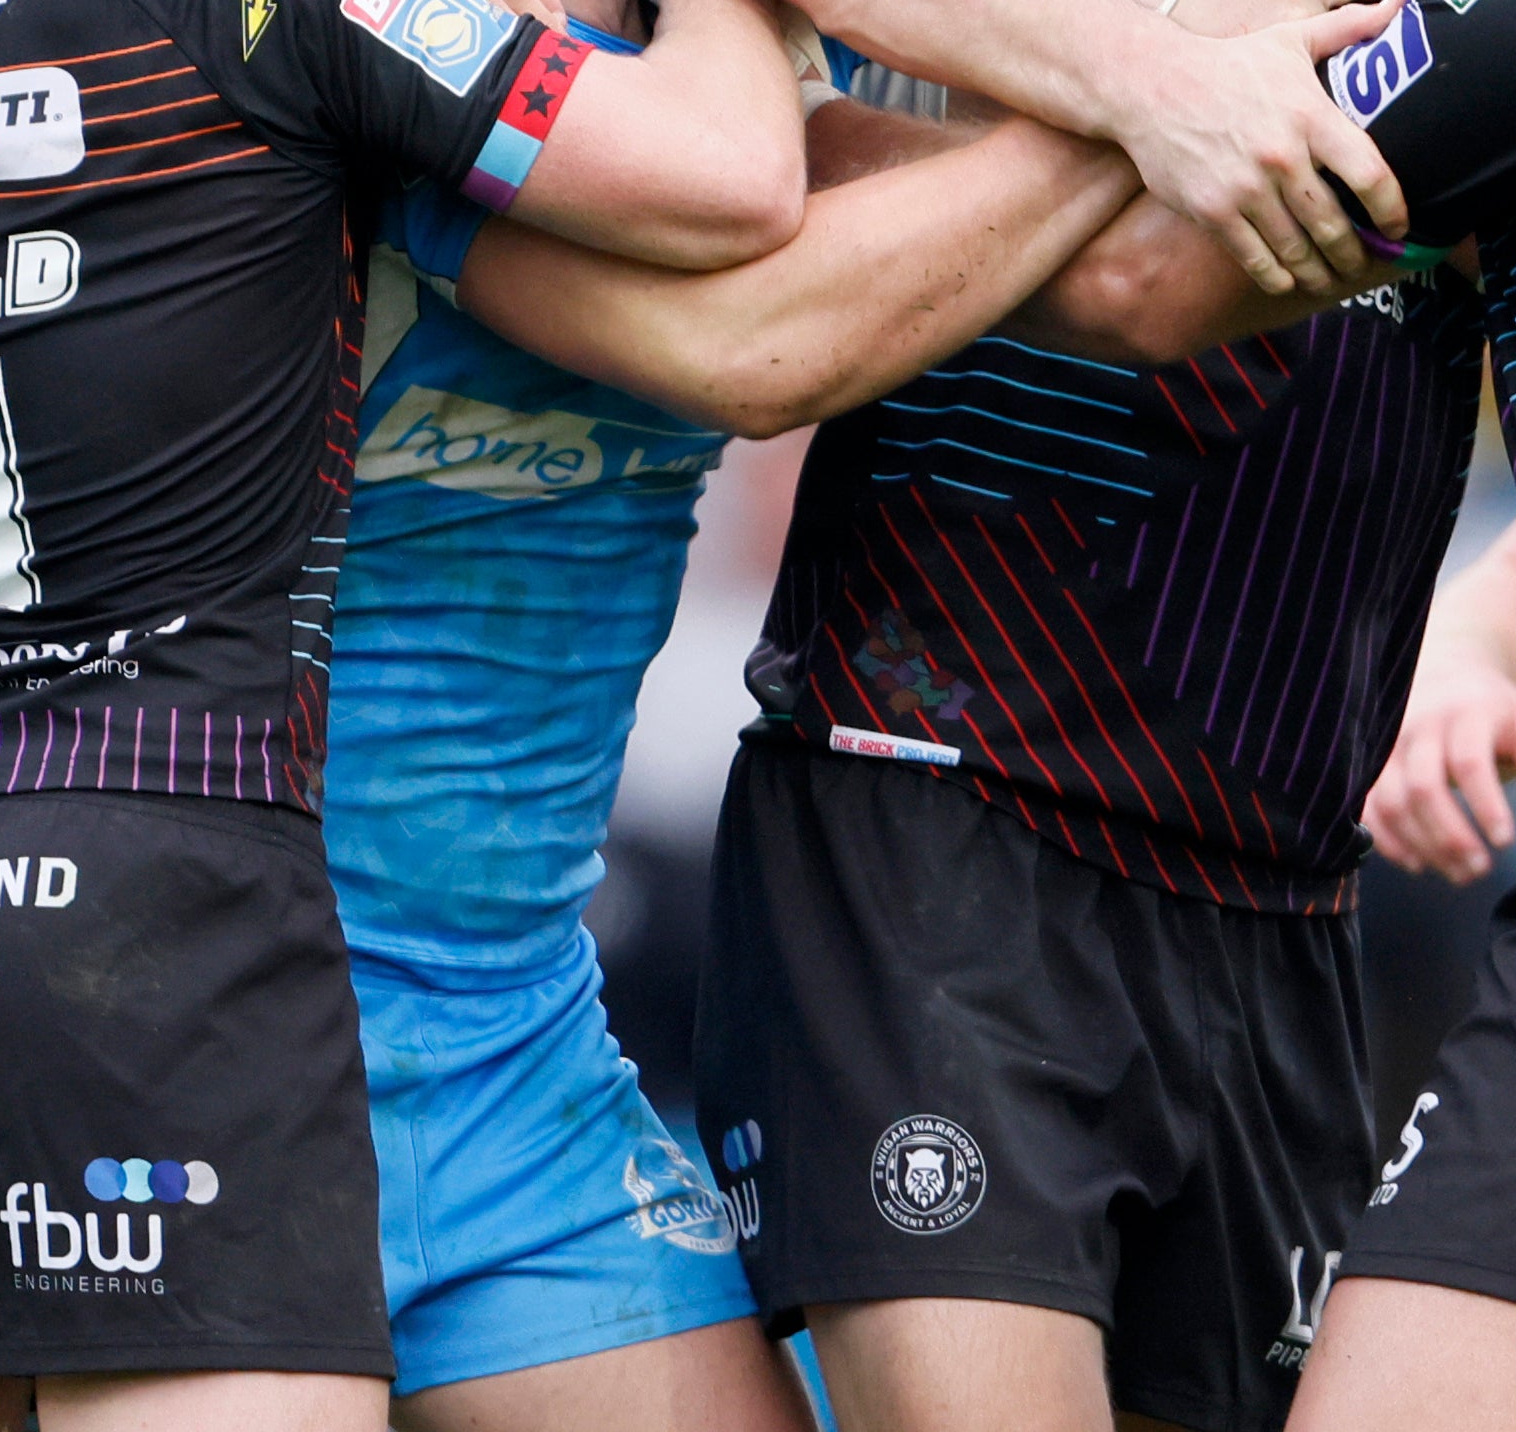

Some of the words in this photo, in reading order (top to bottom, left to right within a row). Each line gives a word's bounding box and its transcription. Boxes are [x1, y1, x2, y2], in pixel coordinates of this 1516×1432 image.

[388, 410, 586, 487] home
[834, 734, 856, 751] THE
[857, 738, 895, 757] BRICK
[875, 1123, 910, 1167] WIGAN
[910, 1119, 980, 1169] WARRIORS
[0, 1182, 162, 1273] fbw
[938, 1200, 971, 1226] LOYAL
[13, 1272, 166, 1296] ENGINEERING
